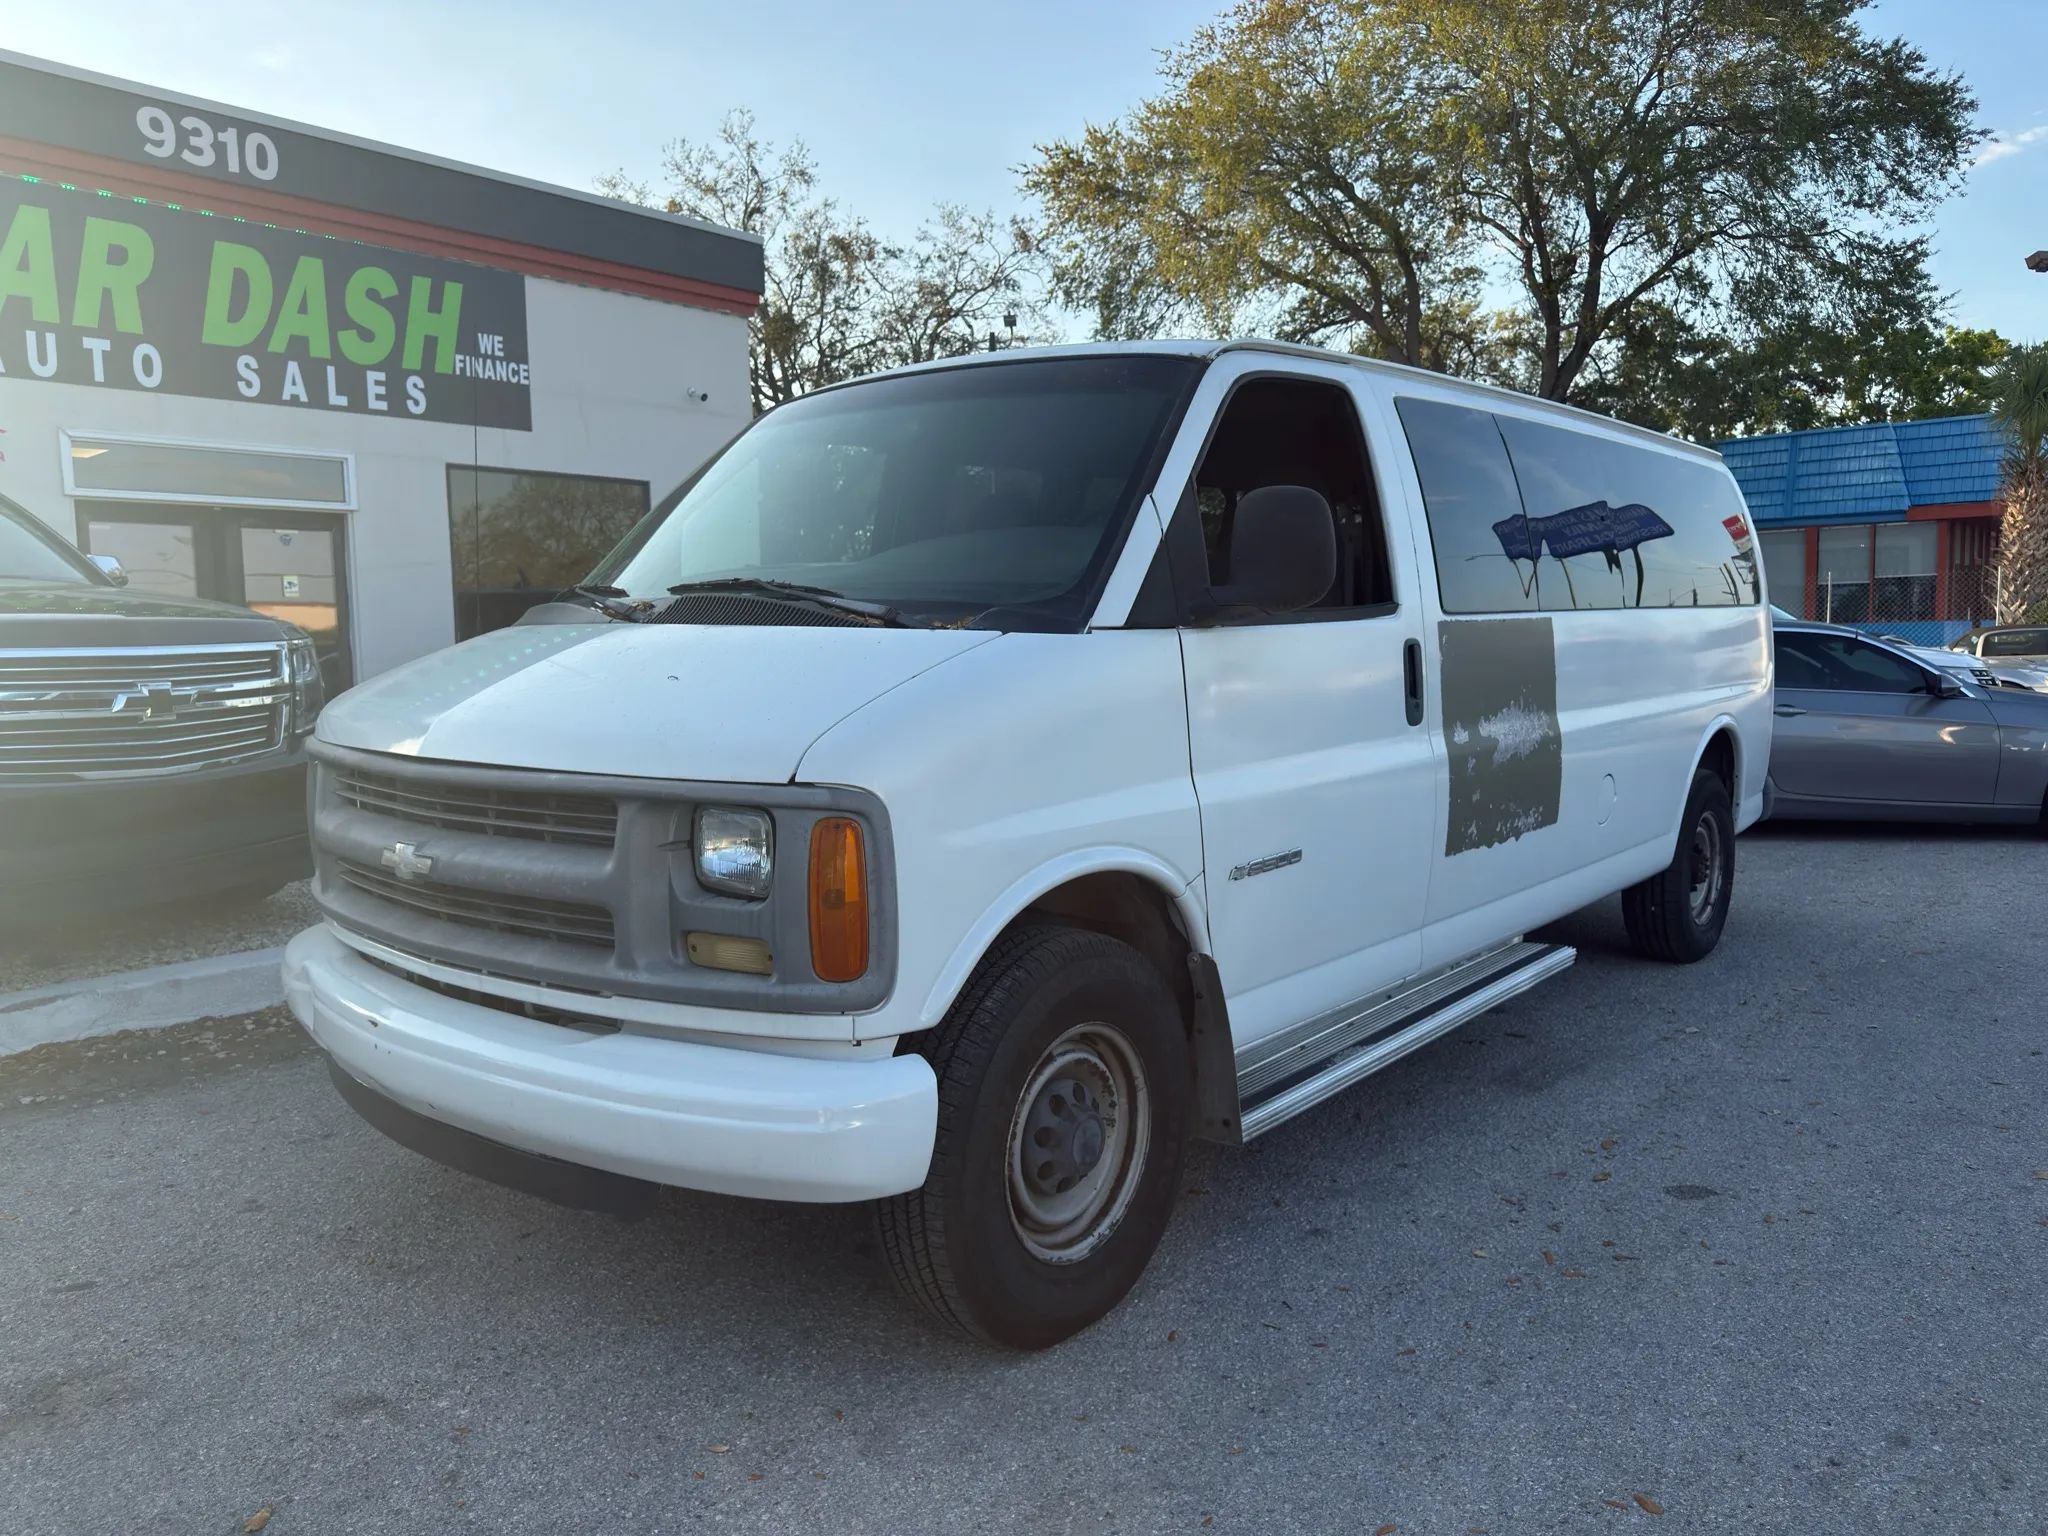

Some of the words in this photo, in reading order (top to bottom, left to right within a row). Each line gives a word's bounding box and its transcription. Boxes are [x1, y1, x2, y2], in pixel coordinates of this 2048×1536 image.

[136, 106, 279, 181] 9310
[202, 240, 463, 374] DASH
[477, 332, 505, 357] WE
[0, 330, 163, 388] UTO
[236, 354, 427, 415] SALES
[455, 353, 530, 385] FINANCE
